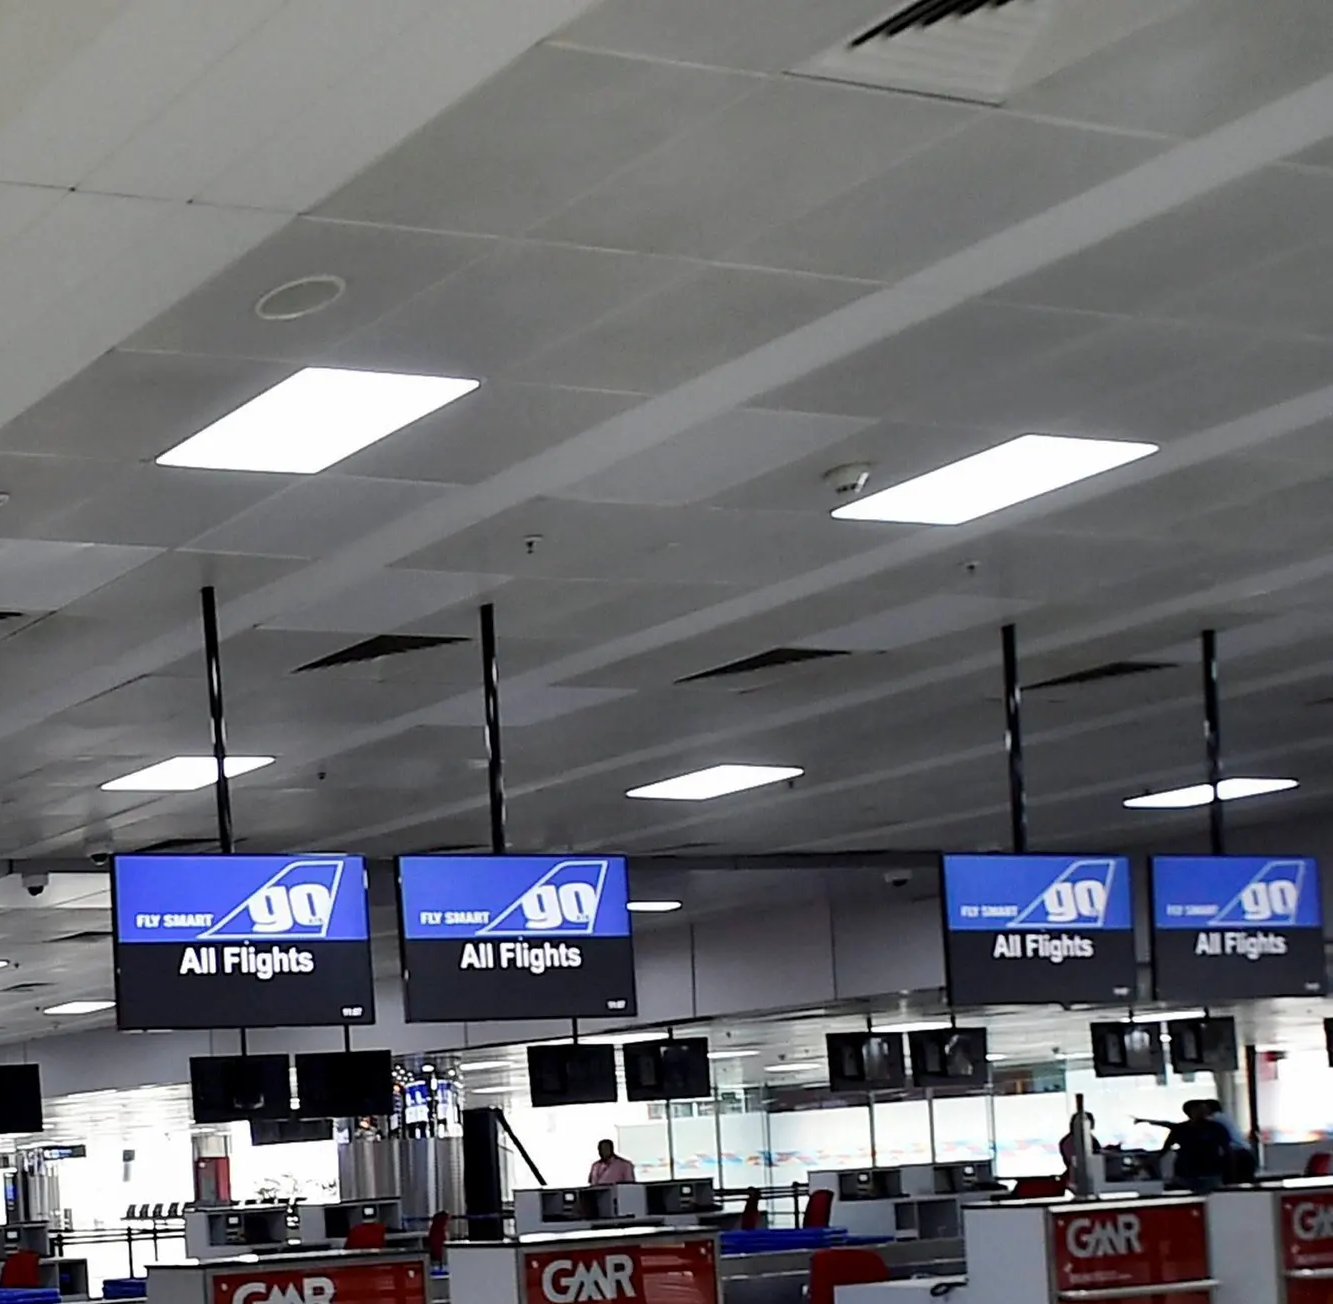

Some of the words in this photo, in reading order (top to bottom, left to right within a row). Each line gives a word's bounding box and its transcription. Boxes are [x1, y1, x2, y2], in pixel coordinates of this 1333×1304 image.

[136, 914, 160, 927] FLY
[164, 913, 214, 927] SMART
[420, 911, 441, 924] FLY
[445, 911, 490, 924] SMART
[180, 947, 216, 974] All
[224, 944, 314, 979] Flights
[461, 943, 493, 968] All
[500, 941, 581, 974] Flights
[994, 934, 1021, 958] All
[1026, 933, 1094, 963] Flights
[1195, 932, 1221, 955] All
[1224, 932, 1287, 960] Flights
[1066, 1213, 1143, 1258] GMR
[542, 1254, 637, 1303] GMR
